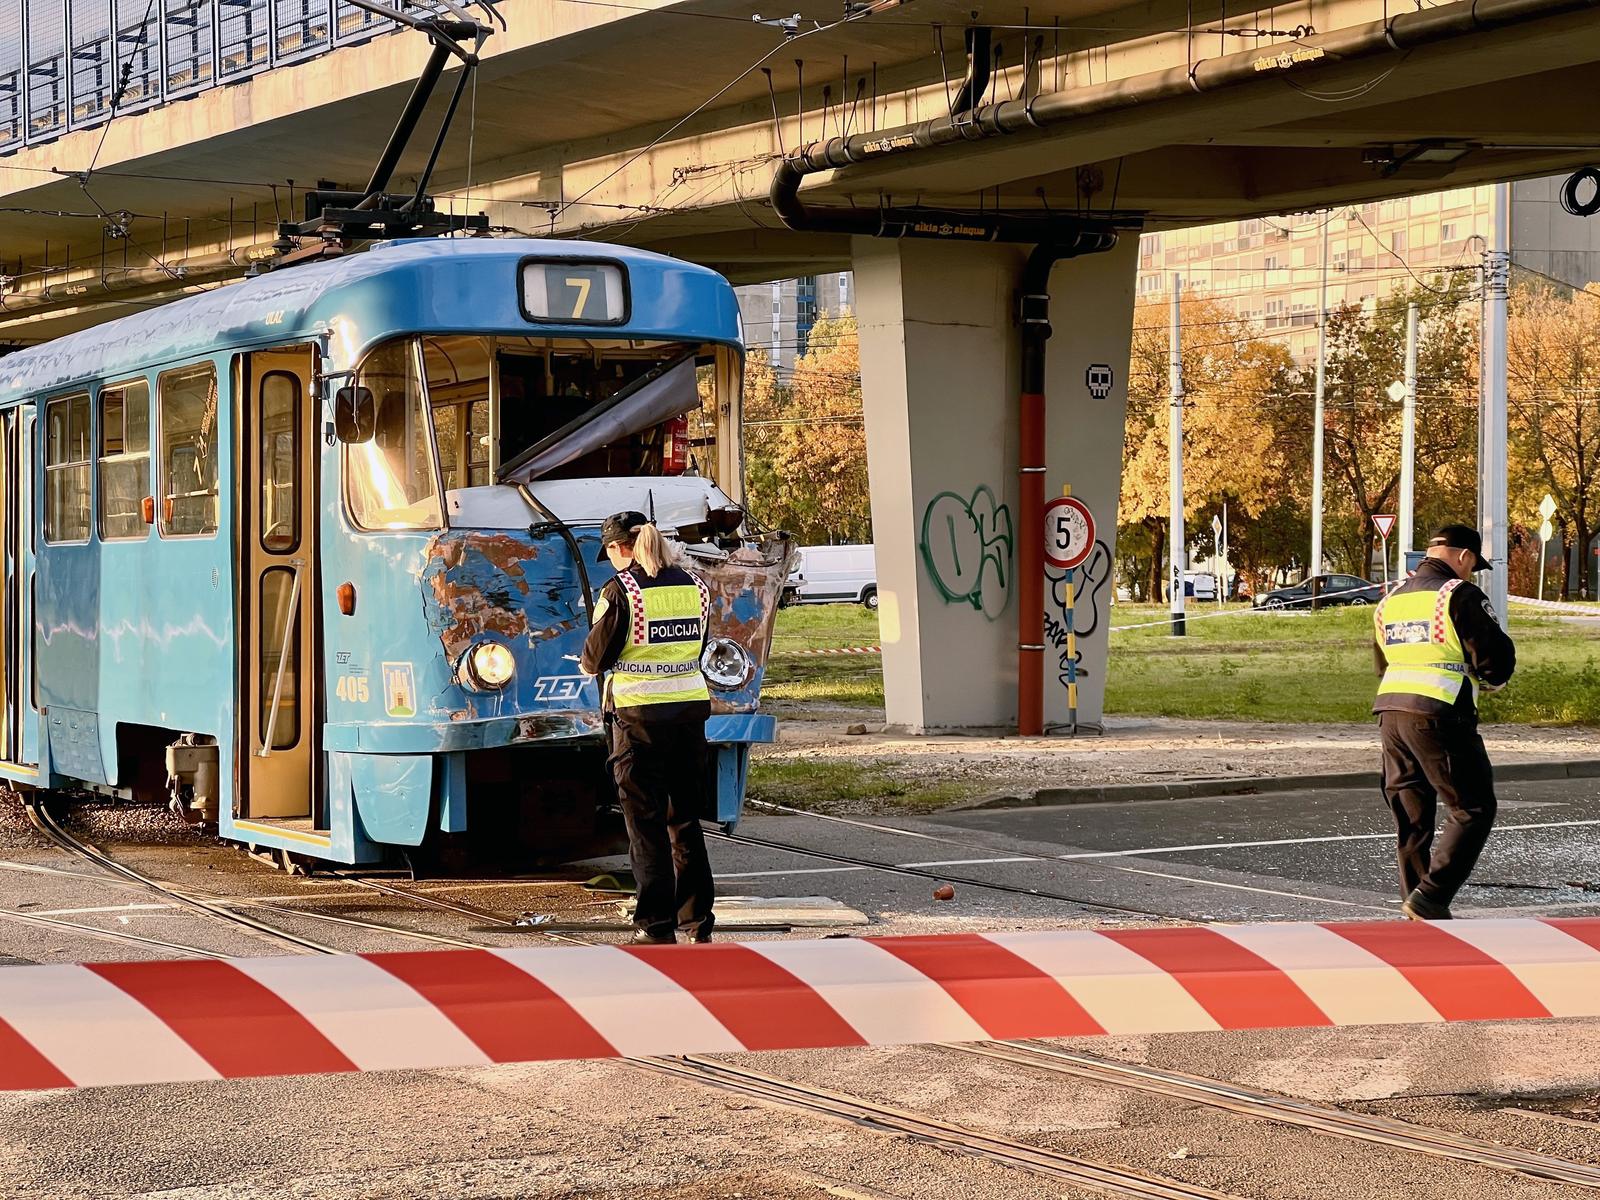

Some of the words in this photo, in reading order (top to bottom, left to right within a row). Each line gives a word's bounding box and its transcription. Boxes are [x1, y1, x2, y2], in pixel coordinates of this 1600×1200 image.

[565, 278, 591, 319] 7
[1056, 516, 1071, 550] 5
[650, 623, 700, 638] POLICIJA
[613, 661, 652, 673] POLICIJA
[656, 661, 694, 673] POLICIJA
[1426, 662, 1465, 673] OLICIJA
[335, 676, 369, 703] 405
[534, 674, 594, 702] ZET
